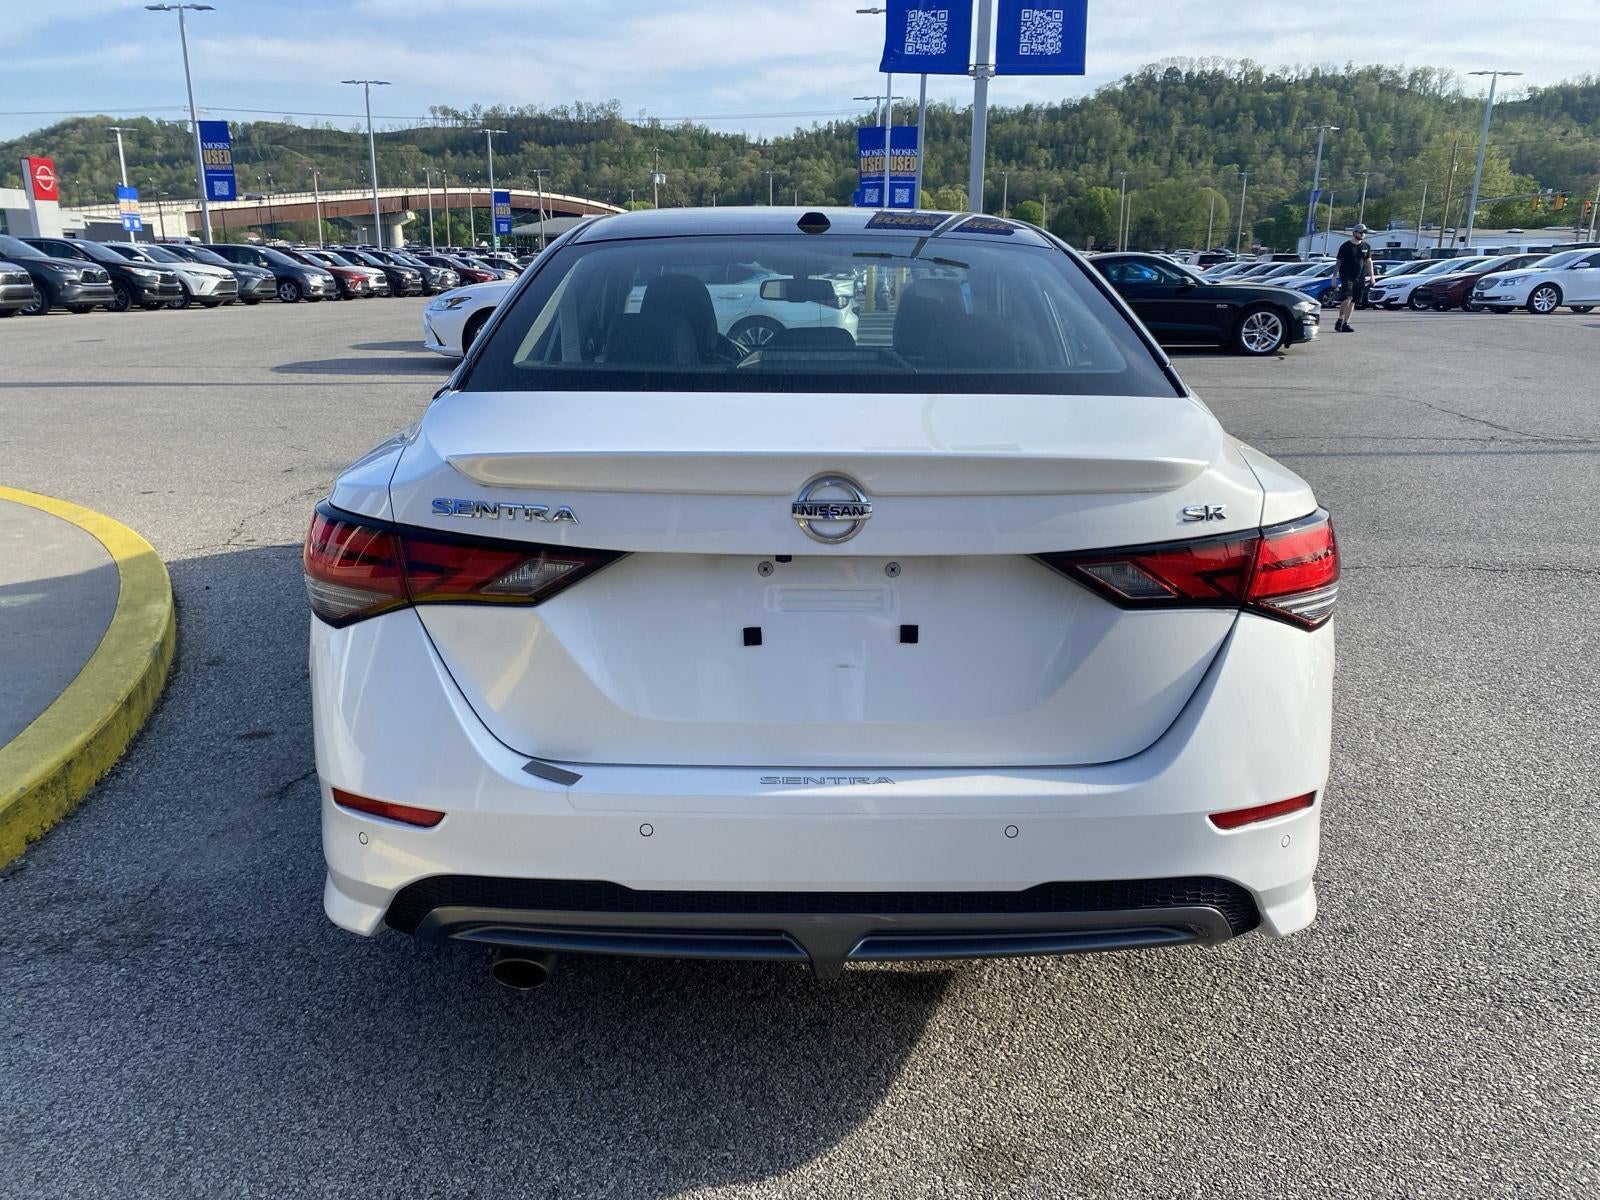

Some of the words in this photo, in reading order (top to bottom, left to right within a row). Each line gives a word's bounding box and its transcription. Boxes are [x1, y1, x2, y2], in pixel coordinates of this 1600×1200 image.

[202, 142, 230, 150] MOSES
[891, 147, 917, 156] MOSES
[203, 149, 232, 165] USED
[860, 156, 885, 172] USED
[890, 155, 917, 171] USED
[431, 498, 579, 525] SENTRA
[800, 505, 866, 517] NISSAN
[1182, 504, 1228, 522] SR
[759, 776, 896, 785] SENTRA
